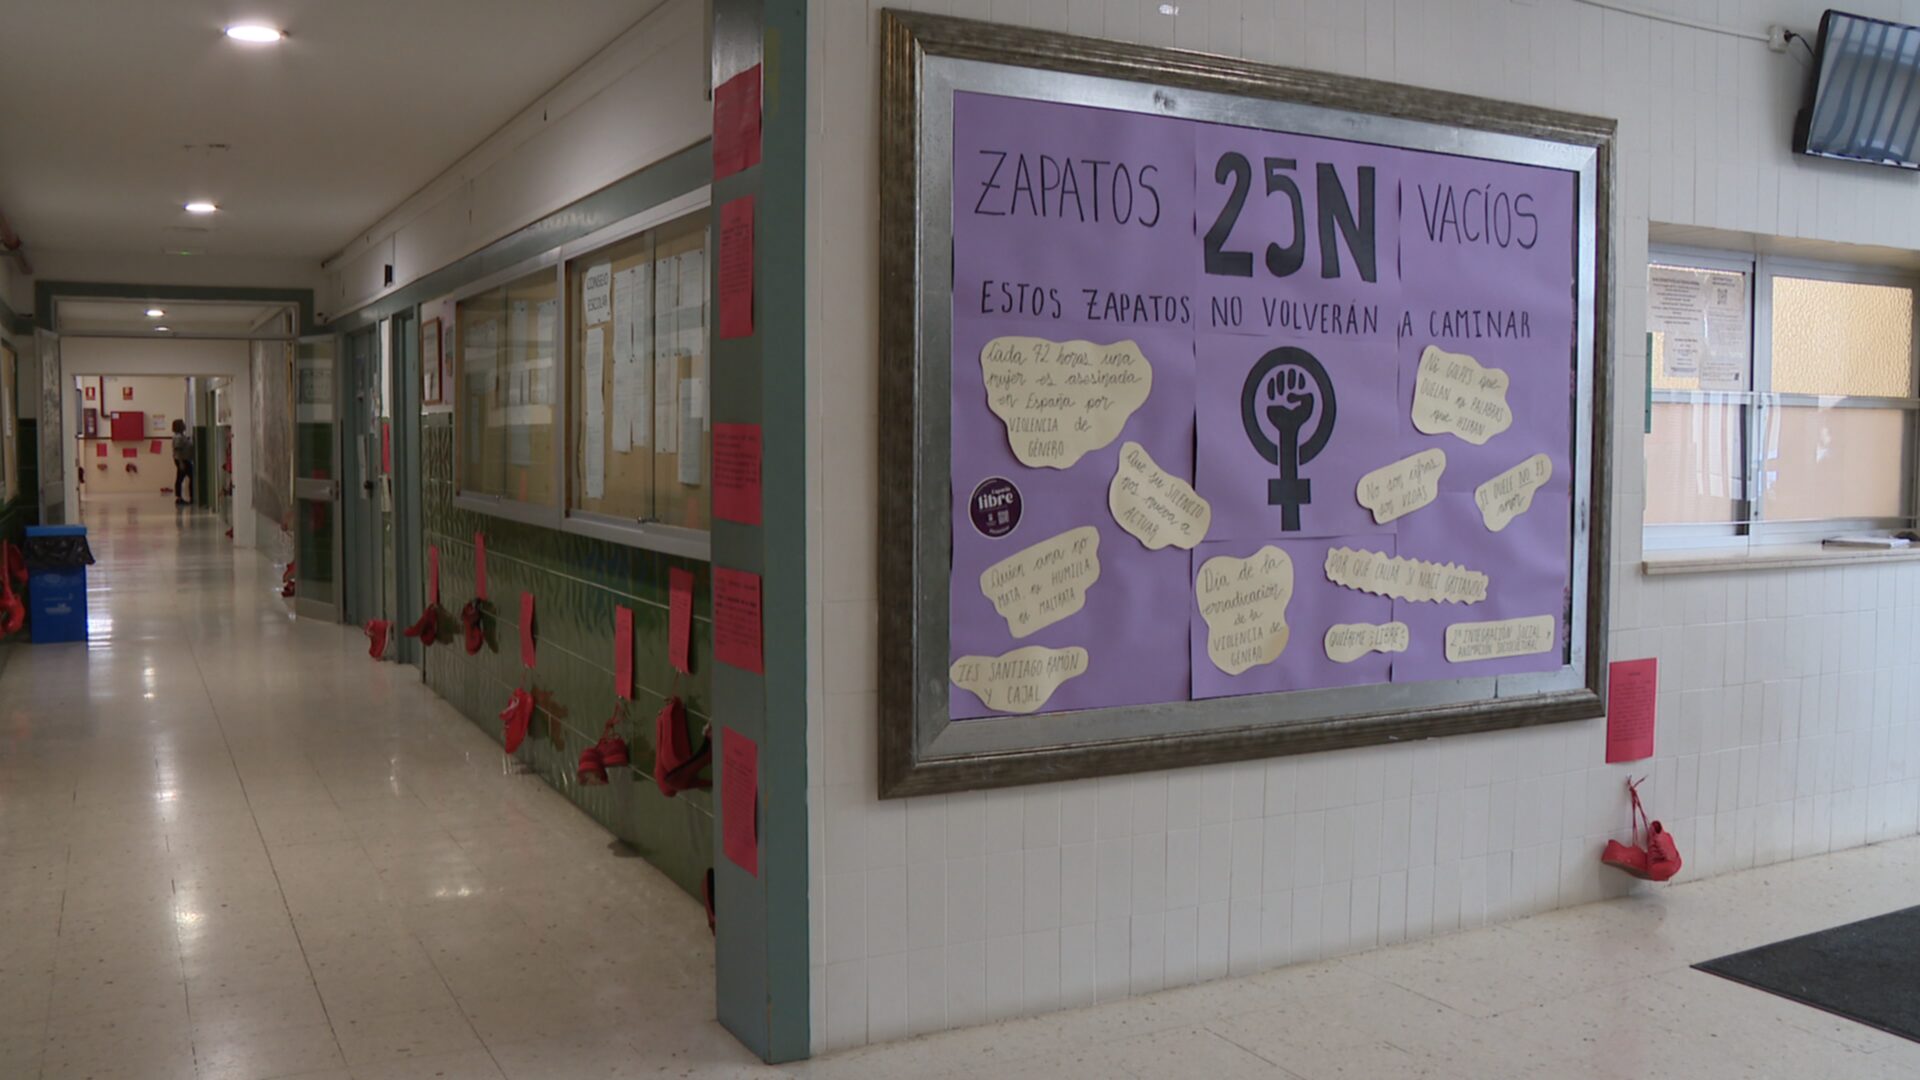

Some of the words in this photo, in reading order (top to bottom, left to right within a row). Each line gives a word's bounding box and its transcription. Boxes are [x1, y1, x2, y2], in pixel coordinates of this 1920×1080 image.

[974, 150, 1160, 227] ZAPATOS
[1204, 151, 1377, 283] 25N
[1417, 183, 1539, 249] VACÍOS
[587, 272, 609, 290] CONSEJO
[981, 280, 1062, 320] ESTOS
[1082, 288, 1190, 324] ZAPATOS
[1211, 296, 1243, 327] NO
[1262, 297, 1378, 334] VOLVERÁN
[1401, 305, 1413, 338] A
[1429, 309, 1532, 339] CAMINAR
[986, 342, 1028, 365] Cada
[1032, 343, 1049, 364] 72
[1056, 346, 1093, 368] horas
[1101, 352, 1136, 366] una
[986, 369, 1026, 390] mujer
[1035, 374, 1056, 386] es
[1064, 369, 1142, 388] asesinada
[998, 393, 1017, 408] en
[1025, 393, 1077, 412] España
[1085, 395, 1115, 413] por
[1470, 396, 1504, 424] PALABRAS
[1009, 417, 1058, 433] VIOLENCIA
[1074, 417, 1092, 432] de
[1028, 438, 1064, 459] GÉNERO
[978, 493, 1014, 510] libre
[1164, 483, 1204, 518] SILENCIO
[1124, 507, 1159, 543] ACTUAR
[1072, 537, 1088, 554] no
[1051, 558, 1090, 586] HUMILLA
[1237, 562, 1254, 582] de
[1260, 553, 1285, 574] la
[1329, 554, 1349, 577] POR
[1039, 587, 1075, 615] MALTRATA
[1233, 612, 1247, 626] de
[1213, 626, 1263, 652] VIOLENCIA
[1269, 620, 1284, 635] de
[958, 663, 981, 682] IES
[989, 658, 1043, 682] SANTIAGO
[1046, 651, 1079, 678] RAMÓN
[984, 688, 992, 704] Y
[1007, 685, 1040, 705] CAJAL
